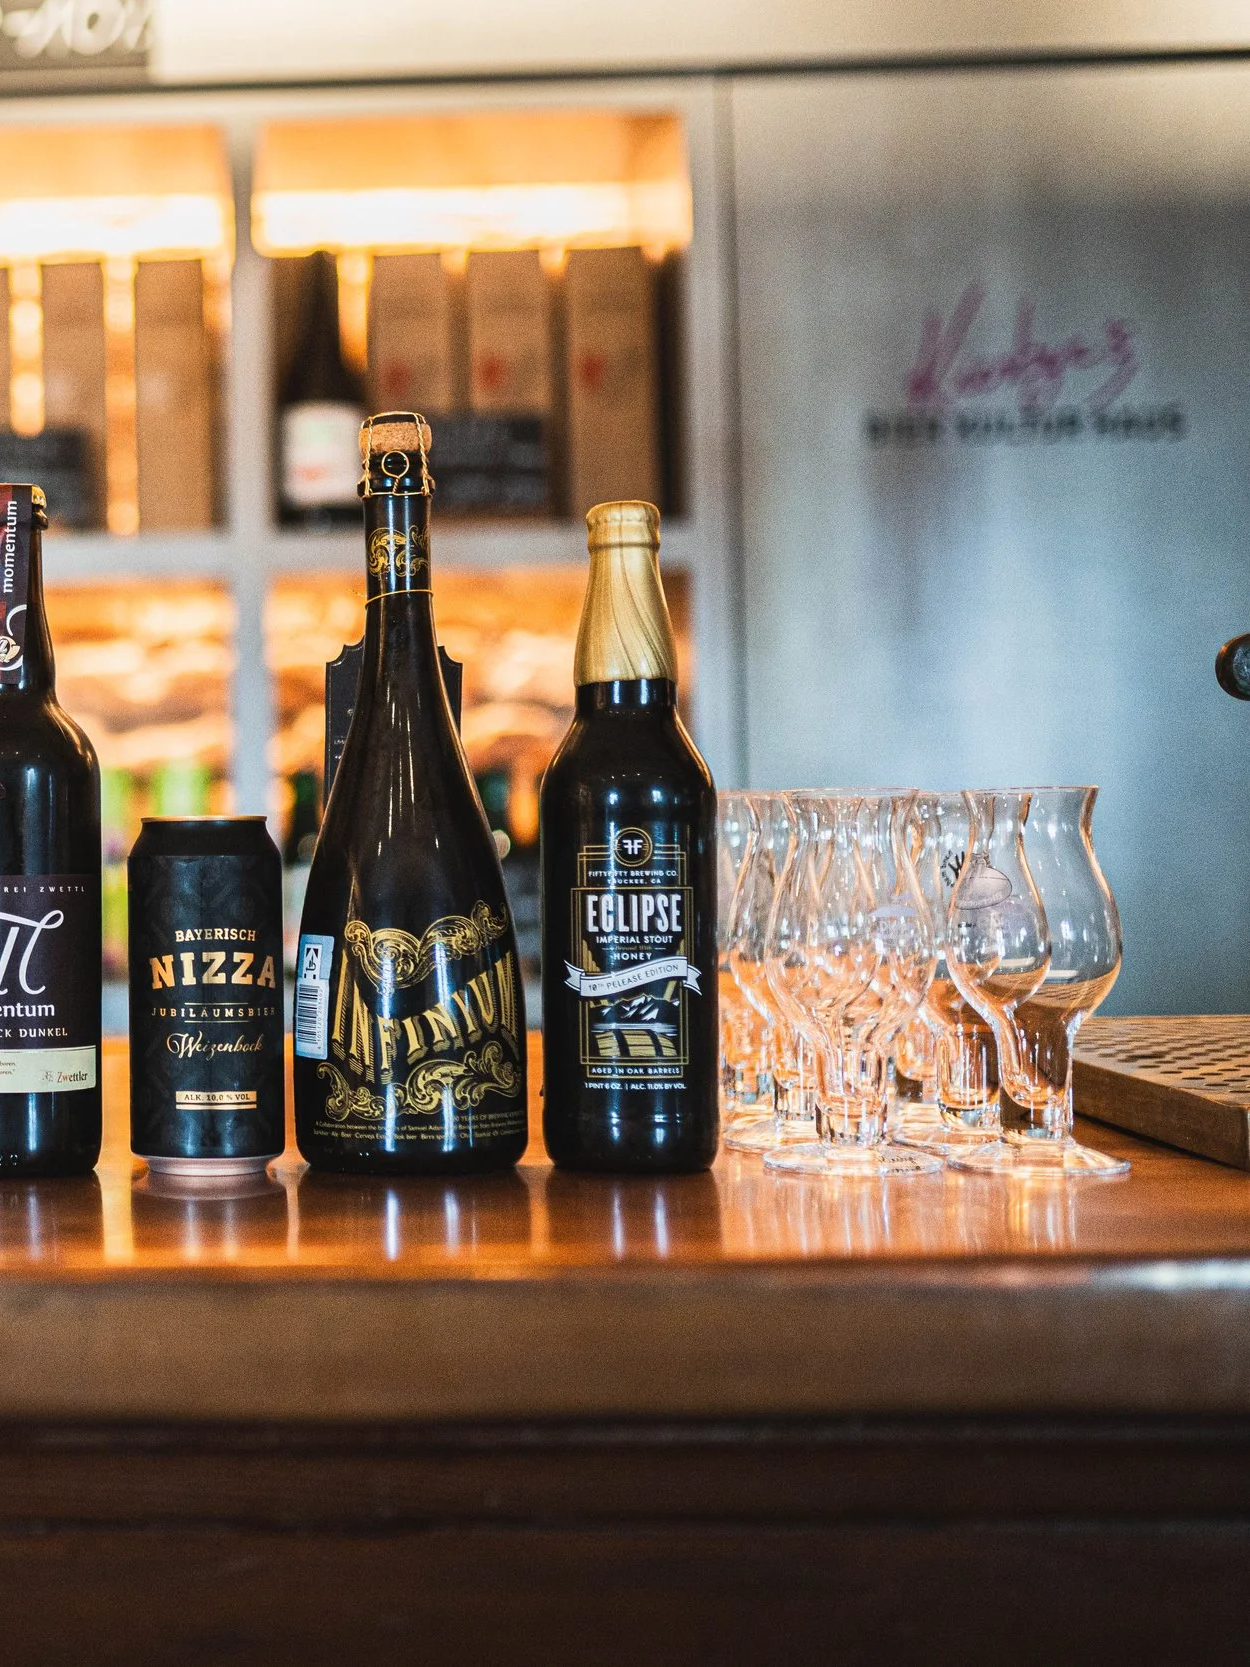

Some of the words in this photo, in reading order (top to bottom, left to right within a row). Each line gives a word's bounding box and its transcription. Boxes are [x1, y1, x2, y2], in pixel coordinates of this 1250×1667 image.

[3, 500, 17, 593] momentum
[586, 893, 682, 933] ECLIPSE
[175, 928, 256, 942] BAYERISCH
[596, 936, 640, 944] IMPERIAL
[643, 936, 673, 944] STOUT
[613, 952, 652, 961] HONEY
[149, 951, 276, 990] NIZZA
[606, 973, 642, 990] RELEASE
[645, 964, 679, 978] EDITION
[151, 1005, 275, 1018] JUBILÄUMSBIER
[19, 1028, 68, 1037] DUNKEL
[166, 1030, 264, 1061] Weizenbock
[57, 1070, 88, 1083] Zwettler
